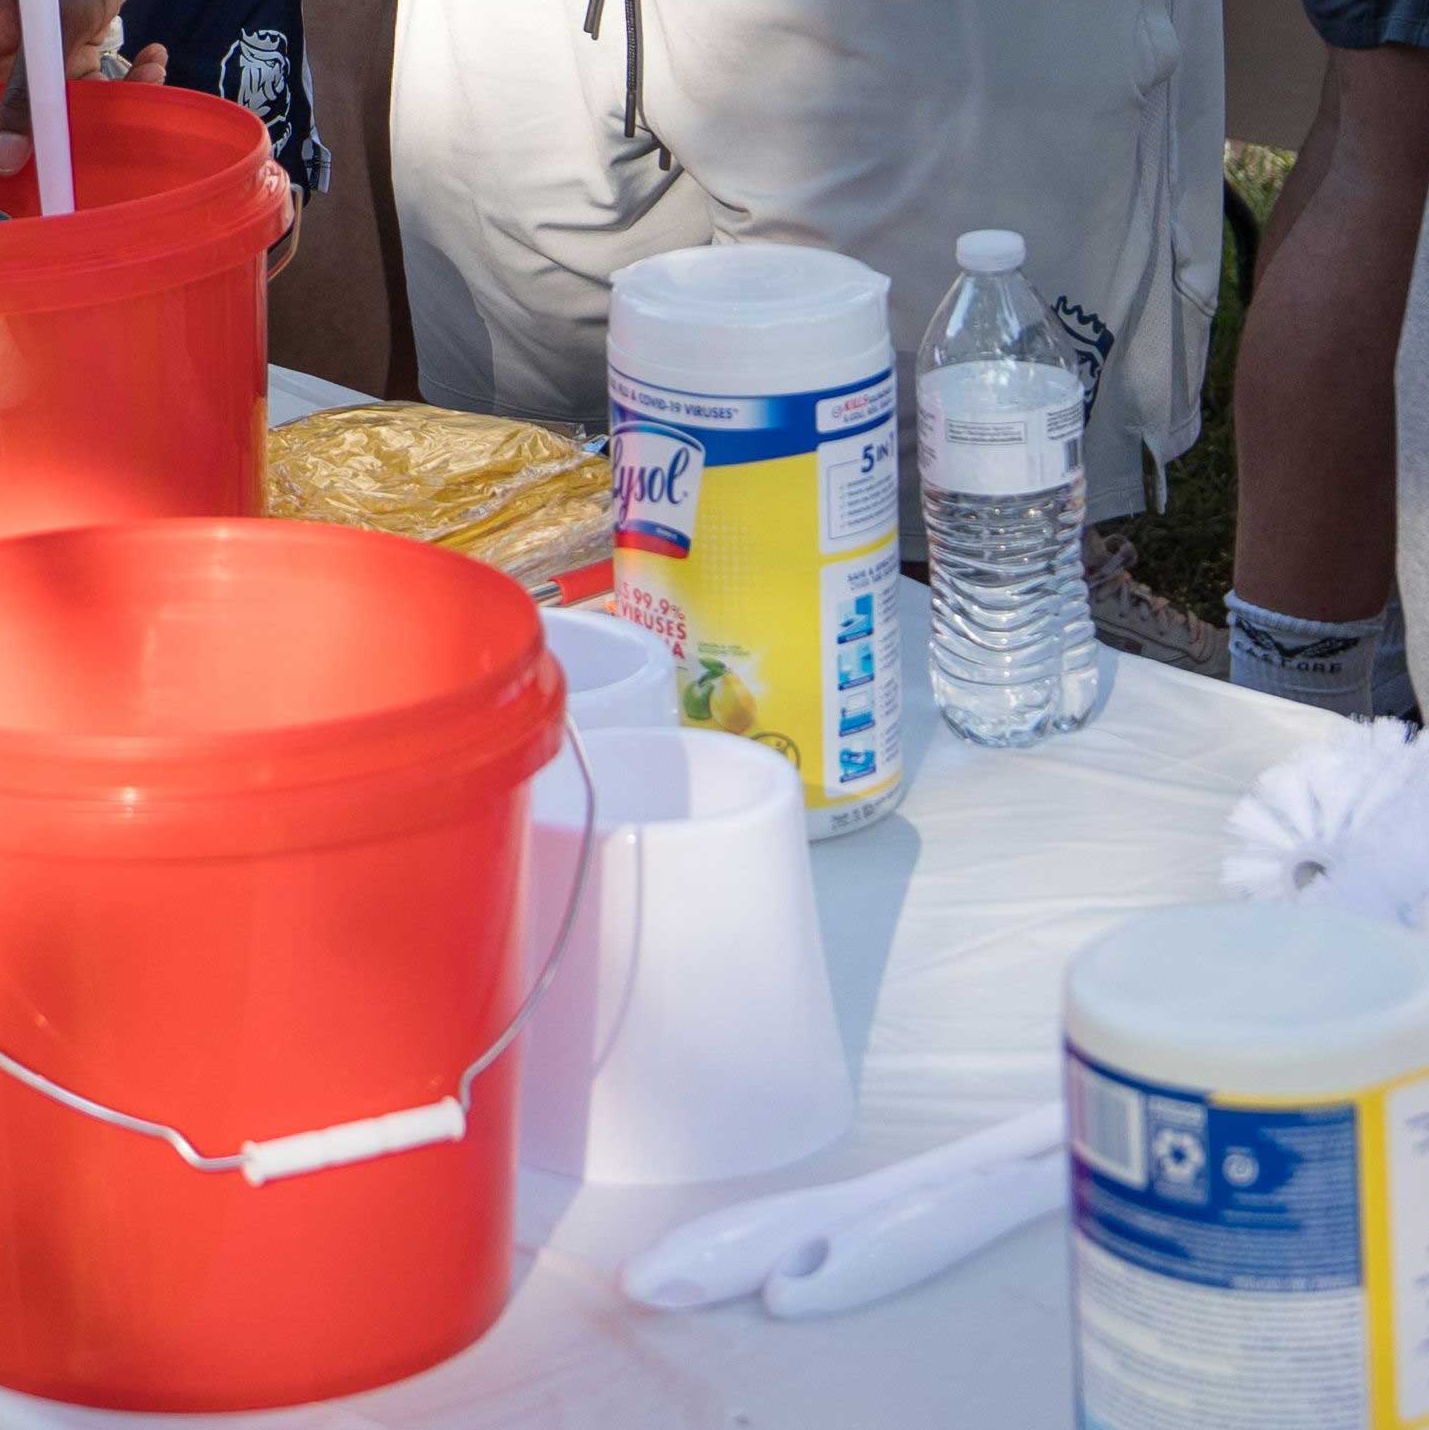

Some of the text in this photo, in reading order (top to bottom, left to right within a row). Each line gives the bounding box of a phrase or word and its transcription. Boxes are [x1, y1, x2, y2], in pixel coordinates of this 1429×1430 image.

[638, 393, 683, 417] COVID-19
[860, 442, 875, 474] 5
[876, 442, 889, 464] IN
[631, 588, 686, 620] 99.9%
[620, 601, 688, 641] VIRUSES
